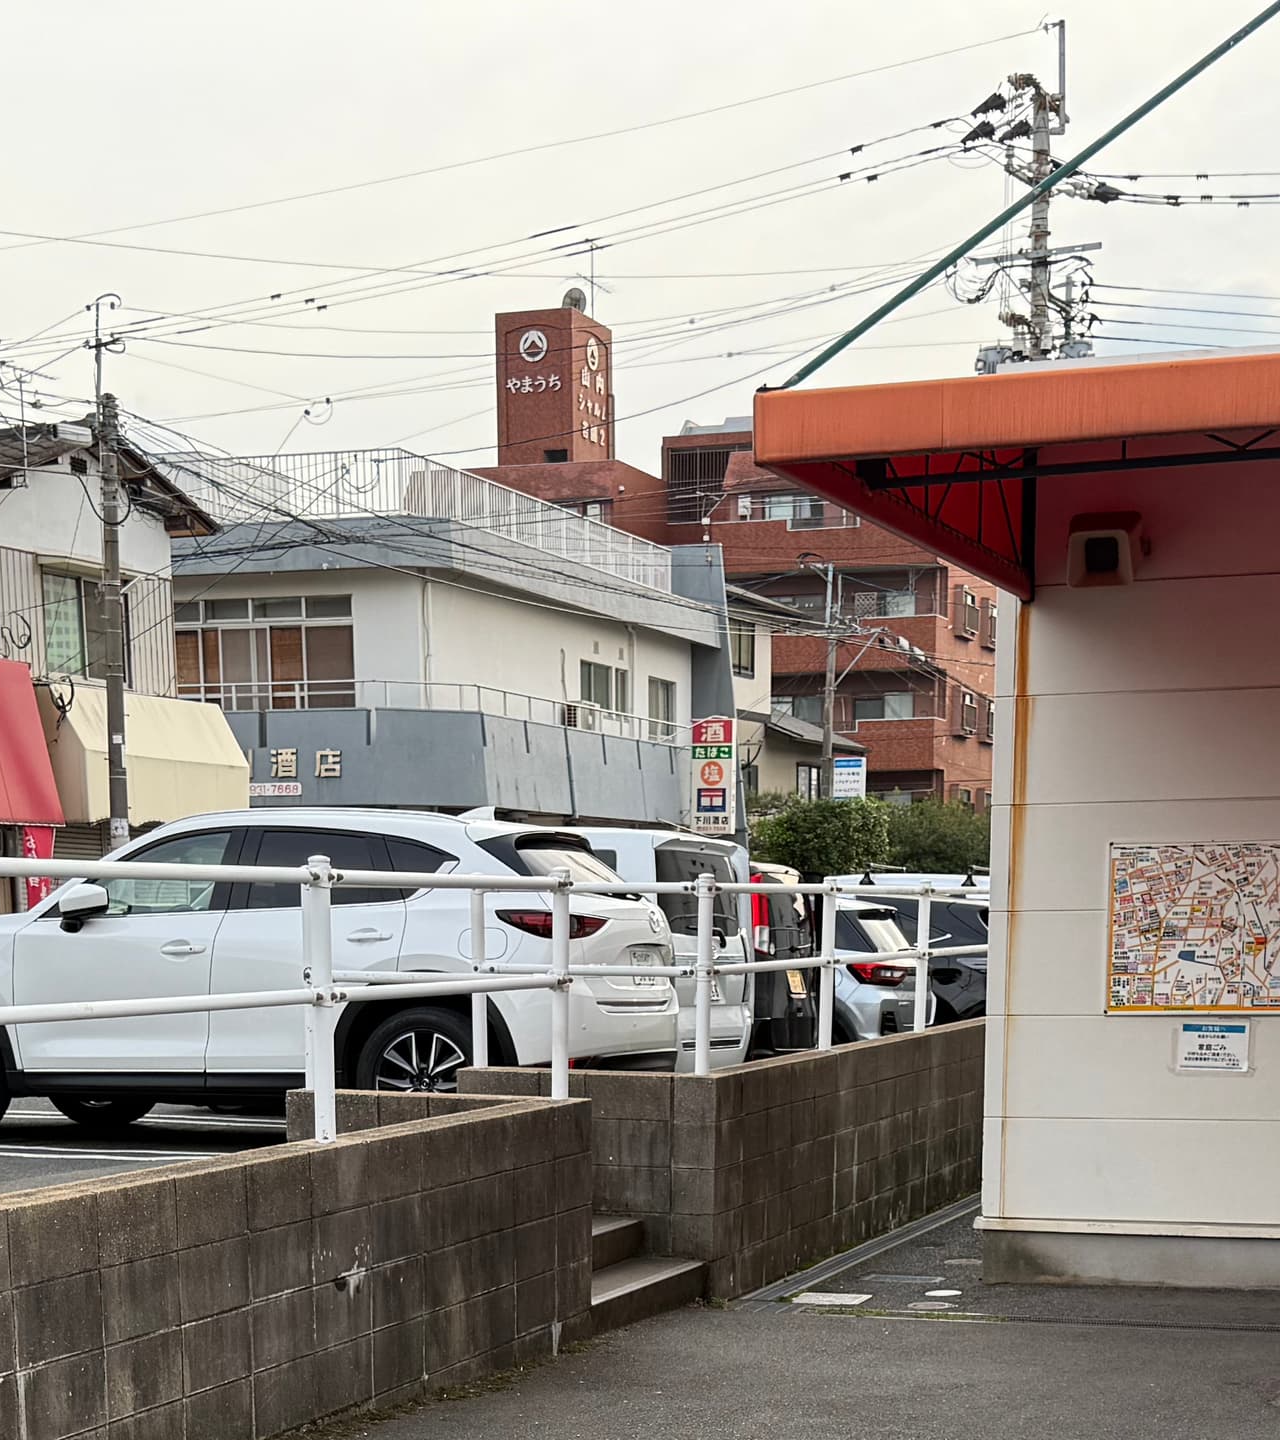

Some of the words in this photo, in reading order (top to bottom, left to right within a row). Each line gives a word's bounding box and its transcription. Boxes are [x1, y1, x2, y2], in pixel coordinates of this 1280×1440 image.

[506, 374, 561, 394] やまうち
[700, 722, 724, 742] 酒
[695, 747, 729, 758] たばこ
[703, 765, 720, 782] 塩
[694, 816, 729, 825] 下川酒店
